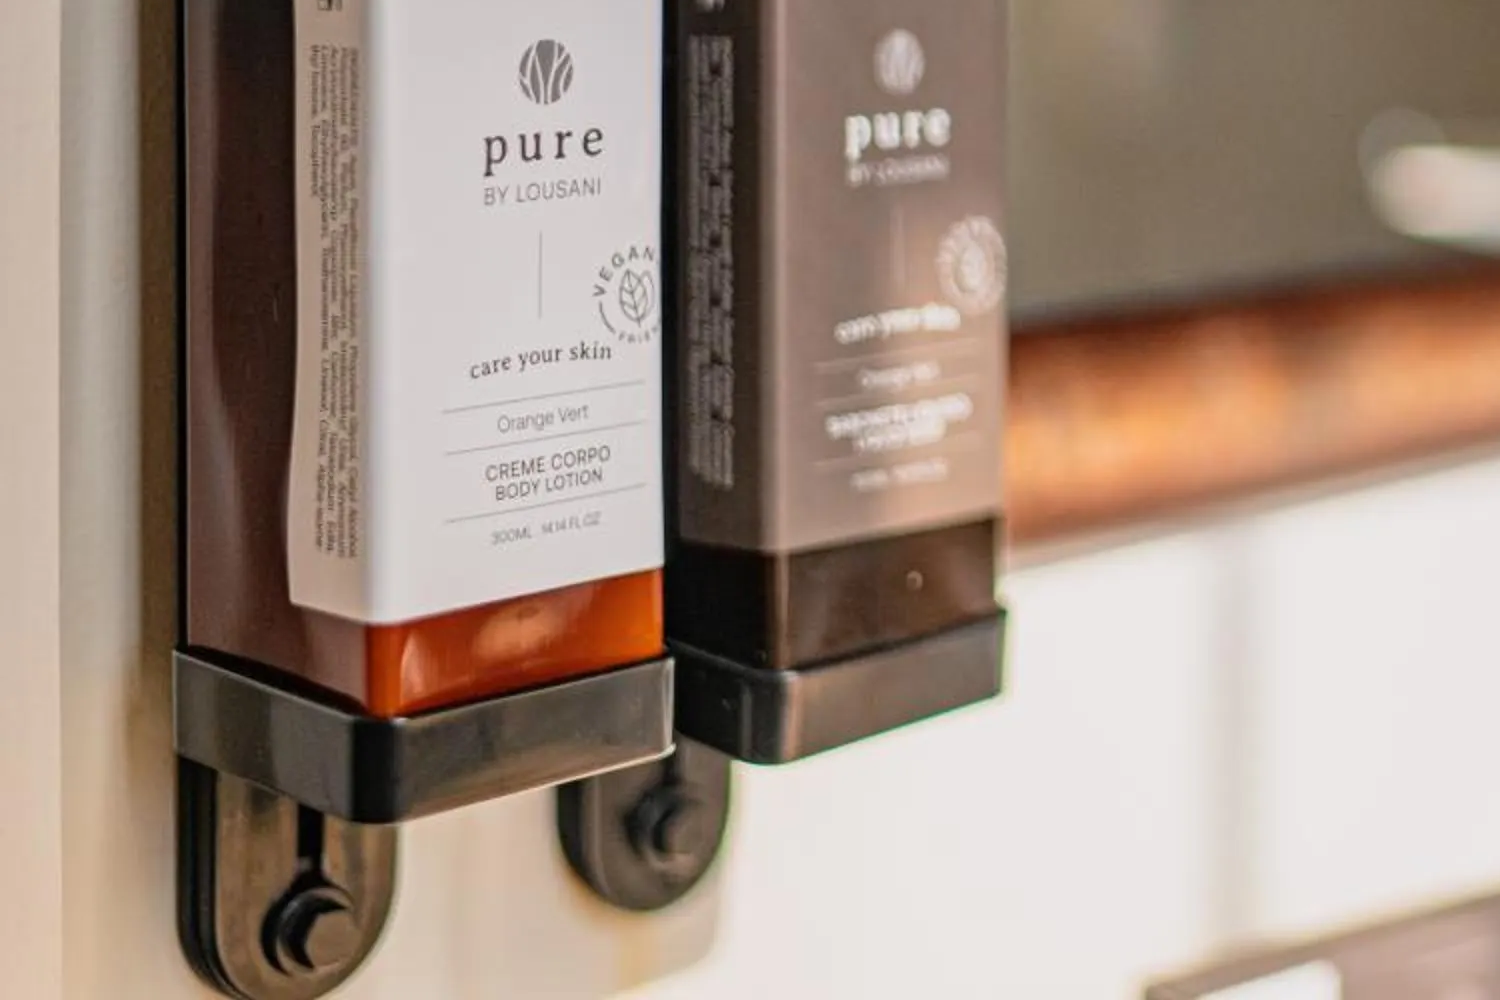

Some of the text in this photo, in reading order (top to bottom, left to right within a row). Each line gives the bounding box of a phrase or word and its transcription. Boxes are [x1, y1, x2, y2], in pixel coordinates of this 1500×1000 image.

[483, 127, 604, 177] pure
[484, 177, 601, 206] BY LOUSANI
[592, 245, 655, 297] VEGAN
[470, 340, 612, 379] care your skin
[497, 404, 589, 434] Orange Vert
[485, 445, 611, 482] CREME CORPO
[495, 466, 602, 501] BODY LOTION
